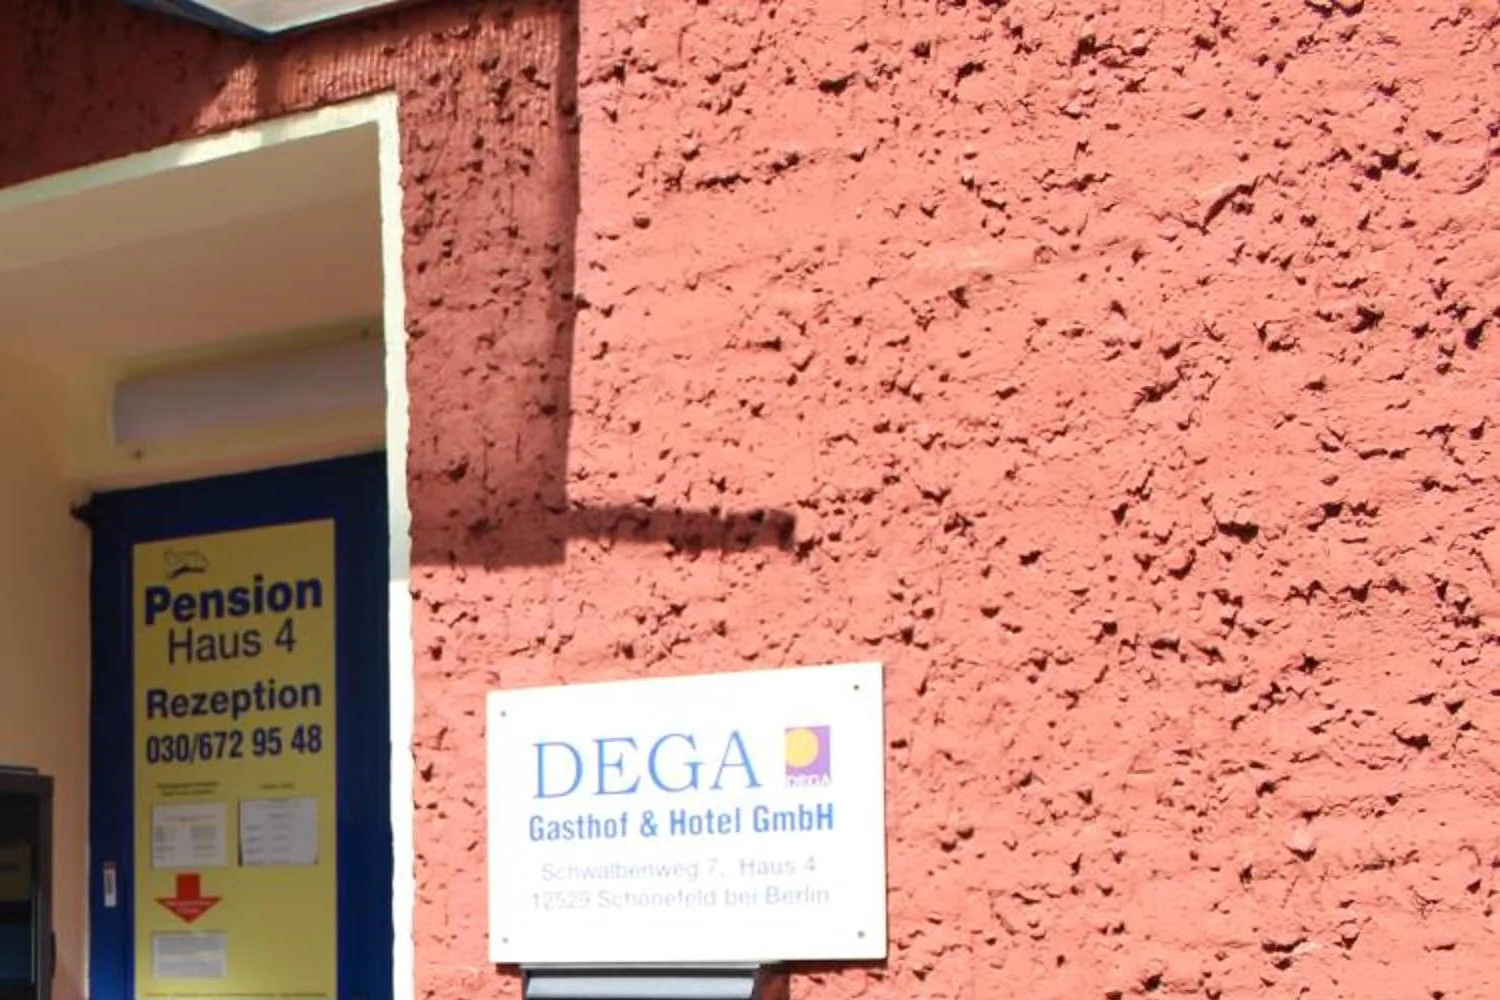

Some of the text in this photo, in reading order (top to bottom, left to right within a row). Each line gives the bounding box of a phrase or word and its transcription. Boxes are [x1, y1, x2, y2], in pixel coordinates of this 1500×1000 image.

[144, 574, 322, 626] Pension
[168, 618, 295, 665] Haus 4
[146, 678, 322, 720] Rezeption
[146, 724, 322, 764] 030/672 95 48
[532, 730, 763, 799] DEGA
[529, 803, 834, 842] Gasthof & Hotel GmbH
[541, 860, 699, 882] Schwalbenweg
[739, 856, 796, 876] Haus
[802, 854, 817, 873] 4
[531, 885, 830, 910] 12529 Schönefeld bei Berlin
